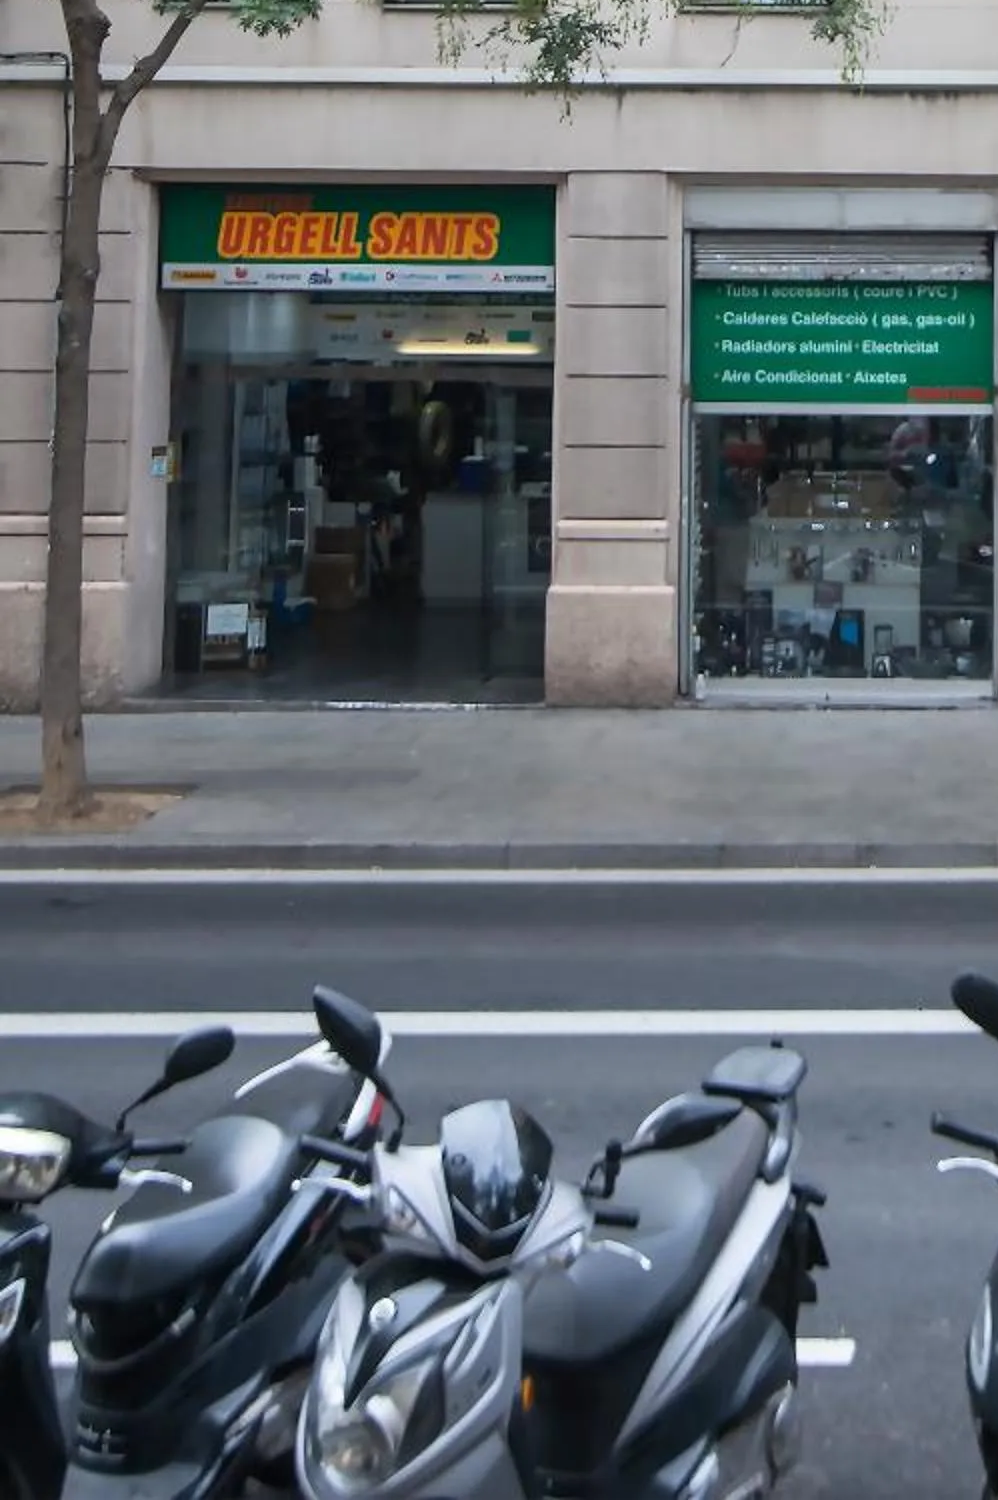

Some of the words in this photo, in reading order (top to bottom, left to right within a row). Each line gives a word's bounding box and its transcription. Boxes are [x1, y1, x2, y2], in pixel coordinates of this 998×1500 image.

[218, 212, 362, 260] URGELL
[367, 212, 500, 260] SANTS
[725, 284, 759, 297] Tubs
[917, 285, 947, 297] PVC
[723, 312, 788, 325] Calderes
[721, 339, 796, 353] Radiadors
[799, 339, 853, 353] alumini
[862, 340, 940, 353] Electricitat
[721, 369, 751, 383] Aire
[755, 369, 843, 384] Condicionat
[853, 371, 907, 384] Aixetes
